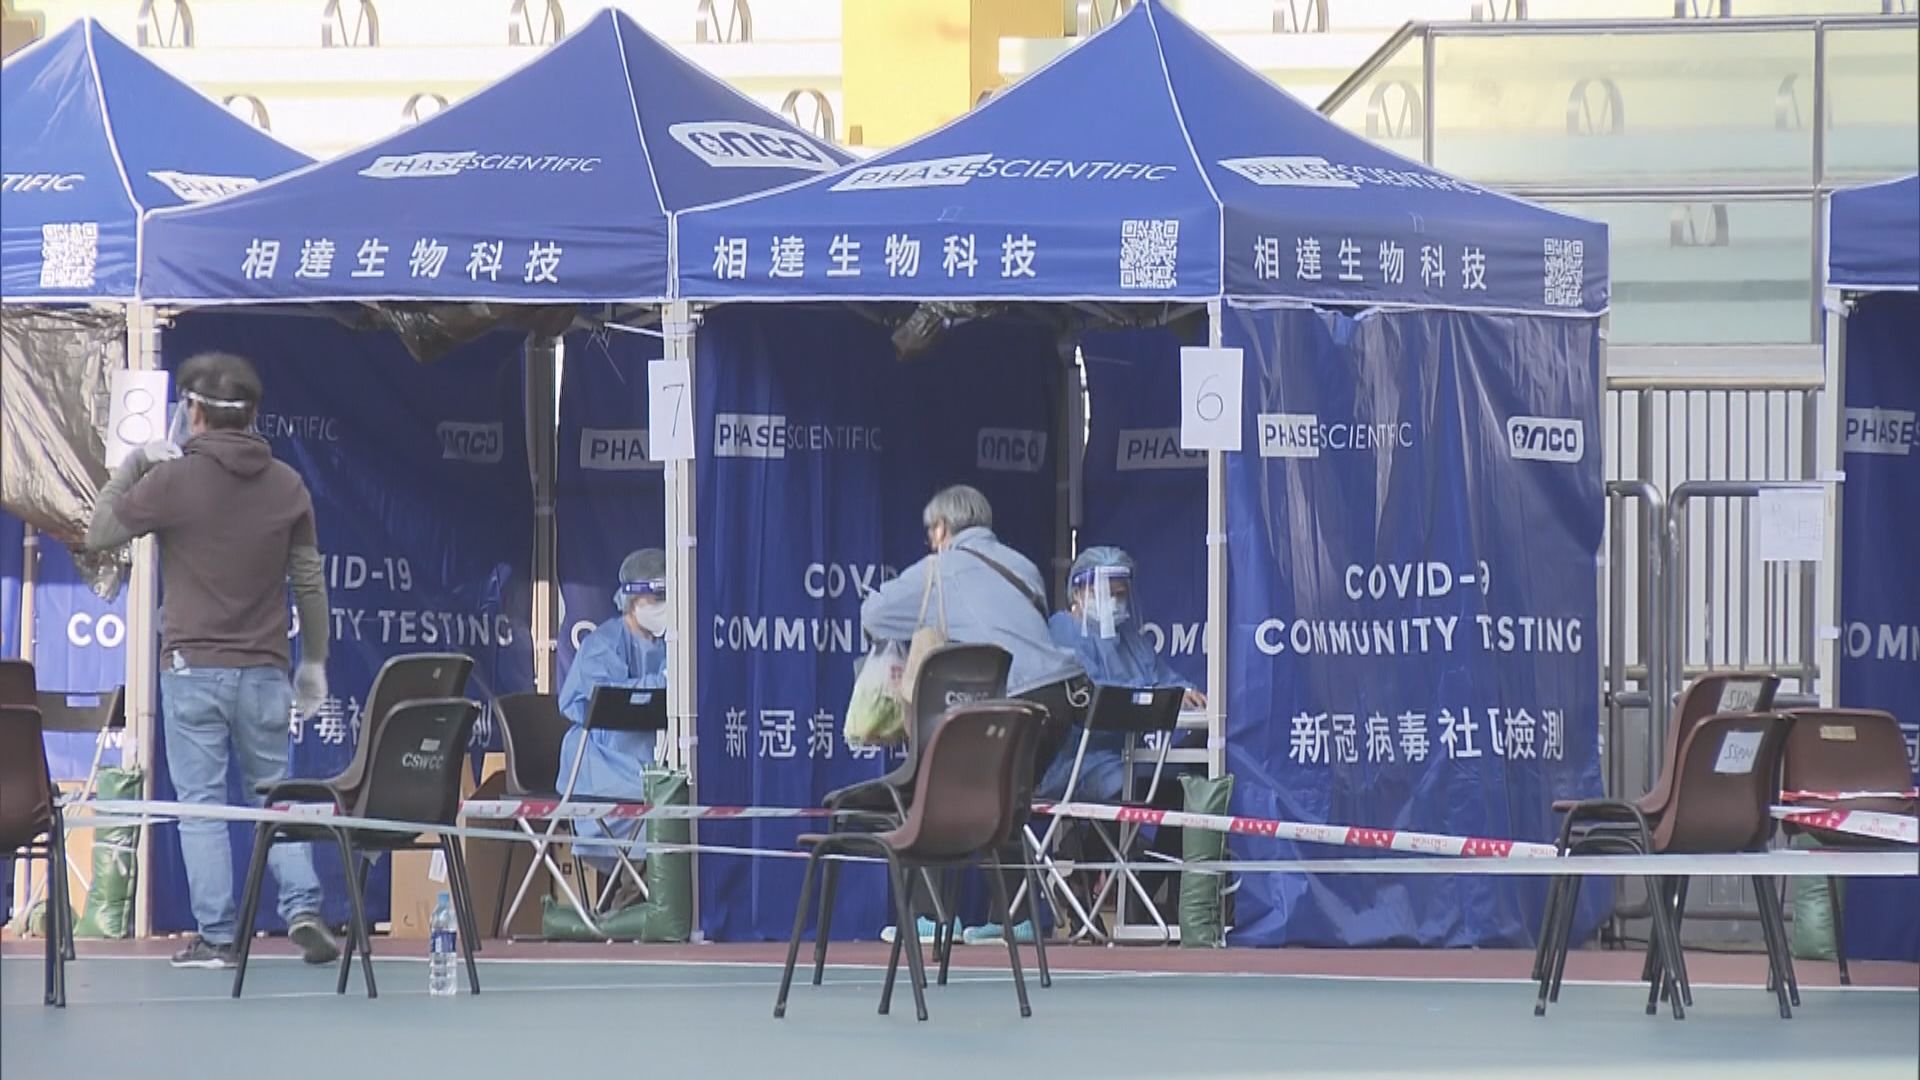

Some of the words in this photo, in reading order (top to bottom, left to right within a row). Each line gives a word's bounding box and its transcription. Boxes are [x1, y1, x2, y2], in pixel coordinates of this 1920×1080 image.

[242, 238, 563, 284] 相達生物科技
[712, 234, 1038, 280] 相達生物科技
[1253, 236, 1487, 291] 相達生物科技
[116, 388, 154, 445] 8
[662, 383, 685, 437] 7
[1196, 373, 1224, 421] 6
[320, 554, 413, 591] ID-19
[377, 609, 513, 646] TESTING
[1254, 615, 1459, 656] COMMUNITY
[1476, 614, 1583, 654] TSTING
